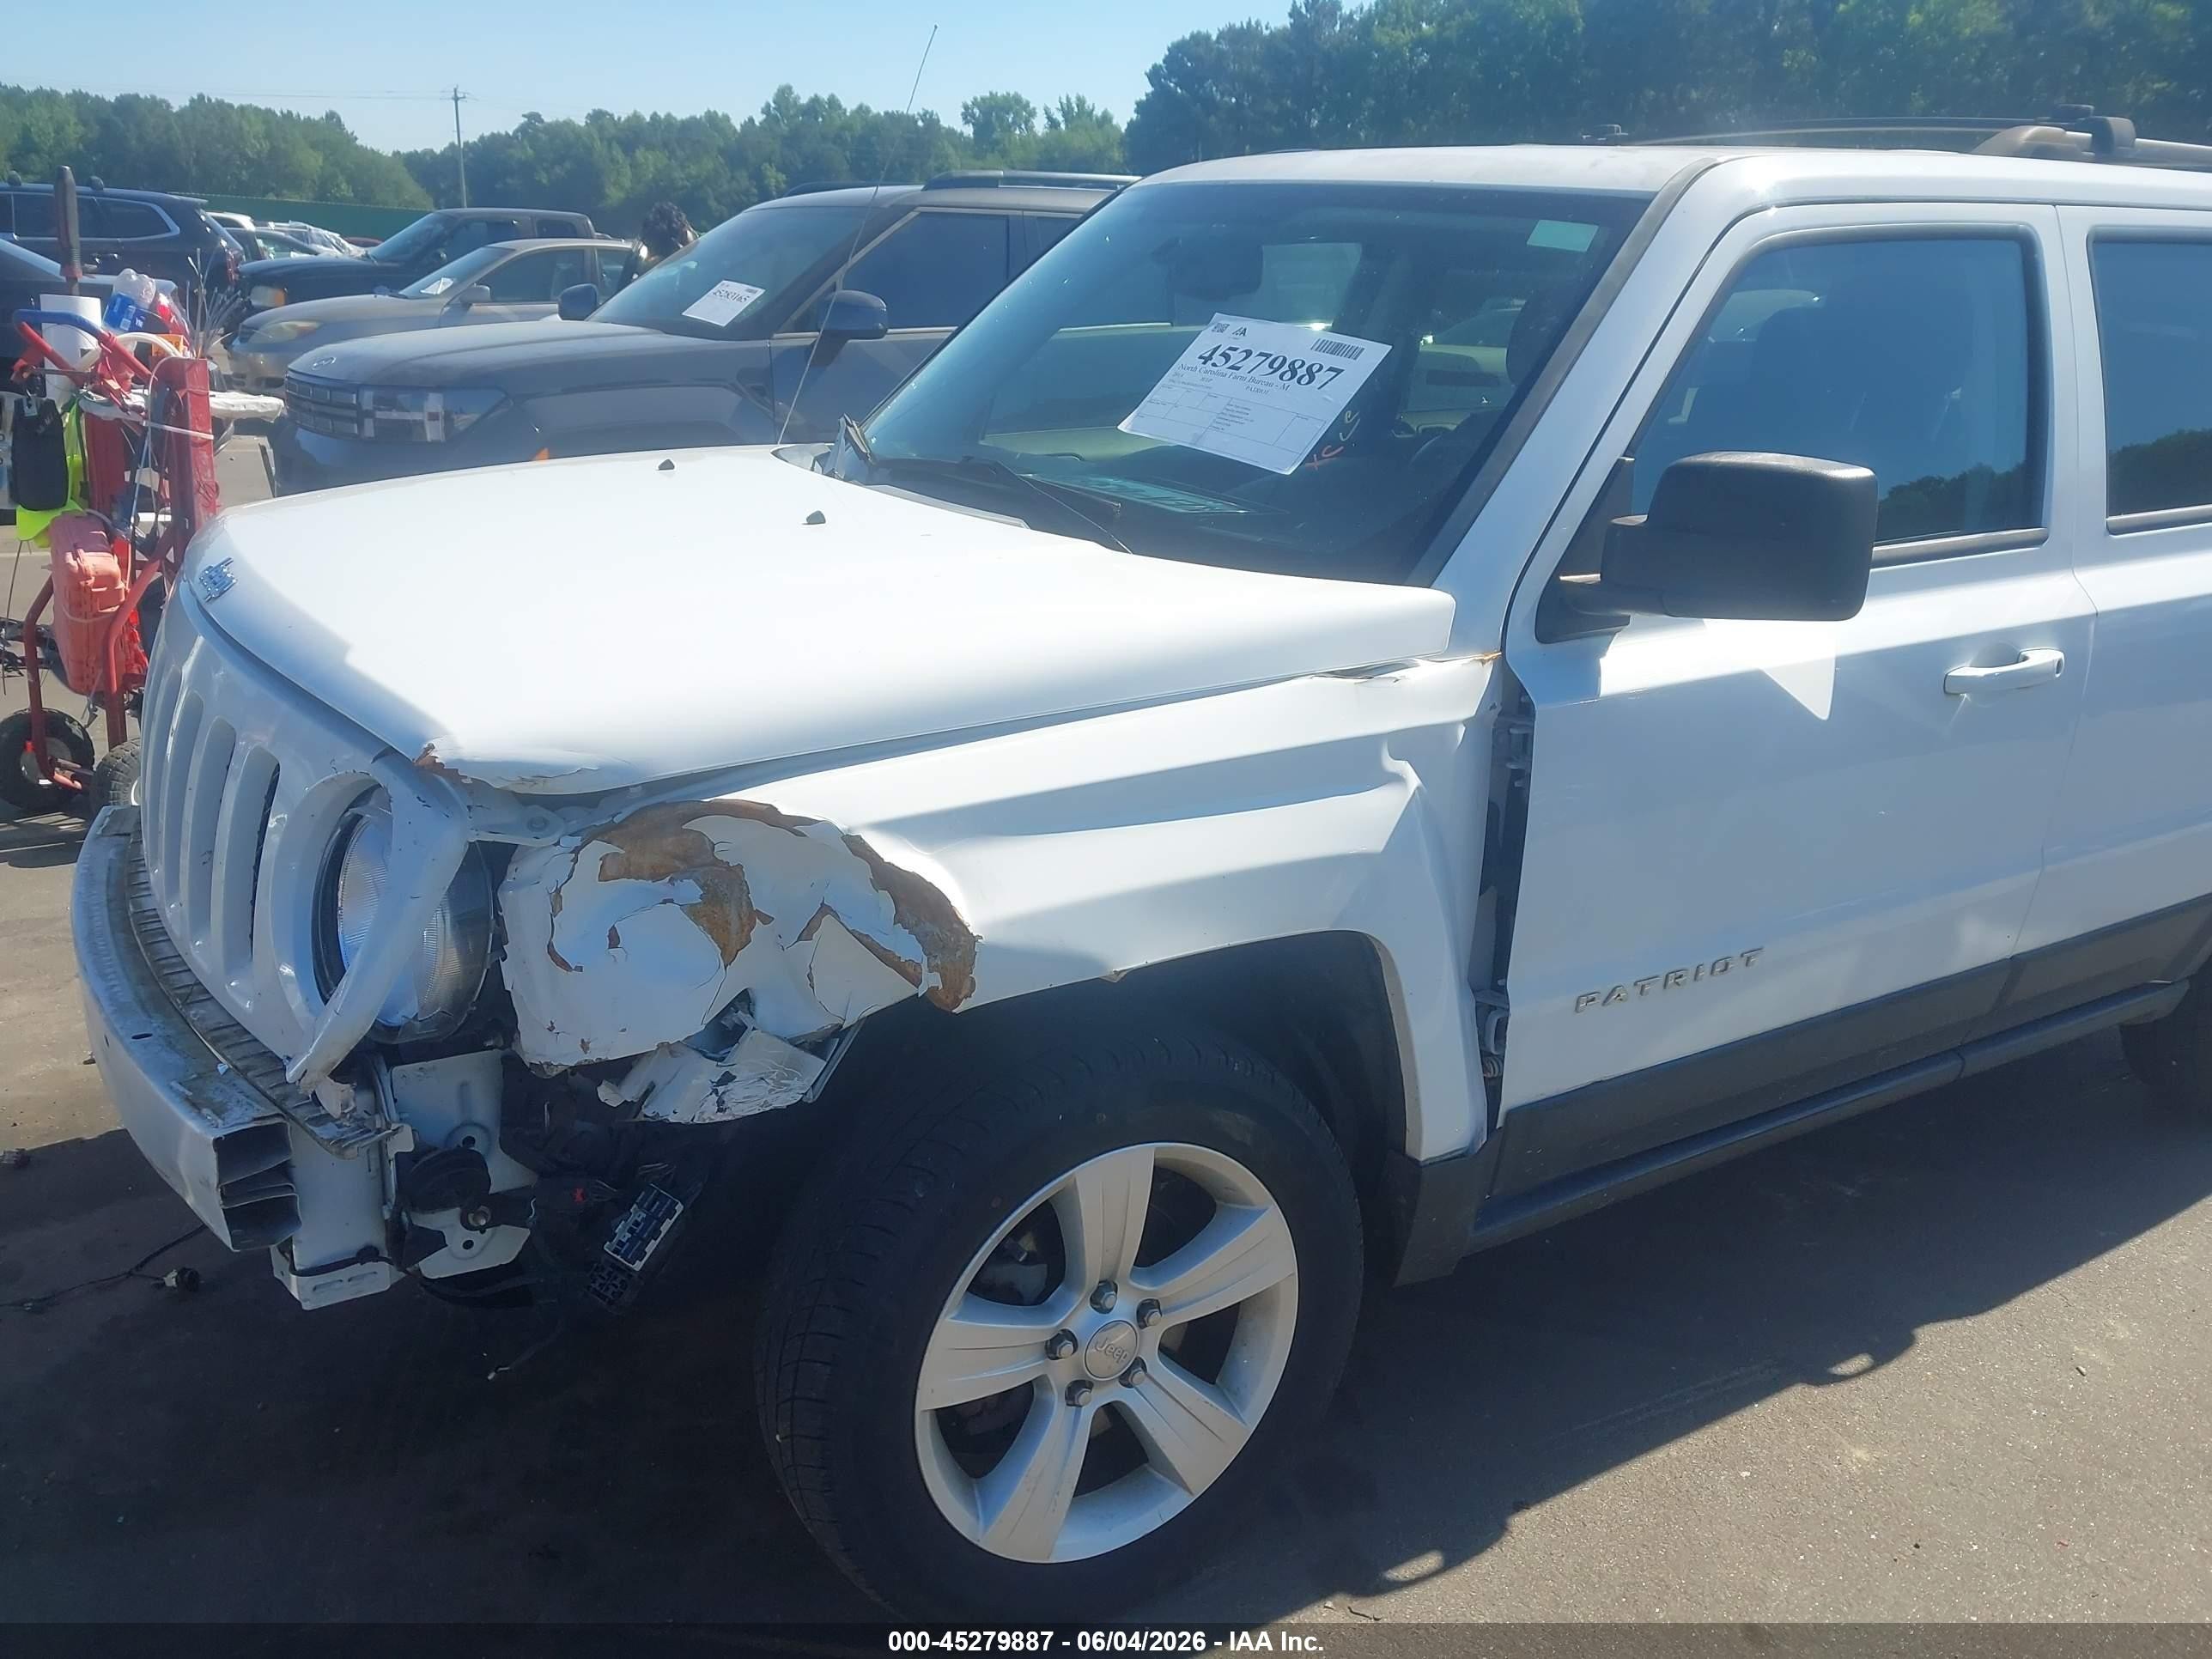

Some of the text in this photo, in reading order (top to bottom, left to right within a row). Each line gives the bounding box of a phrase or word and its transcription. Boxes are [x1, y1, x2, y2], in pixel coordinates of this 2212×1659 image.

[1177, 363, 1198, 373] North
[1199, 365, 1228, 379] Carolina
[1228, 373, 1248, 382] Farm
[1248, 375, 1274, 388] Bureau
[1197, 343, 1346, 390] 45279887
[1574, 946, 1765, 1013] PATRIOT
[1095, 1337, 1129, 1364] Jeep
